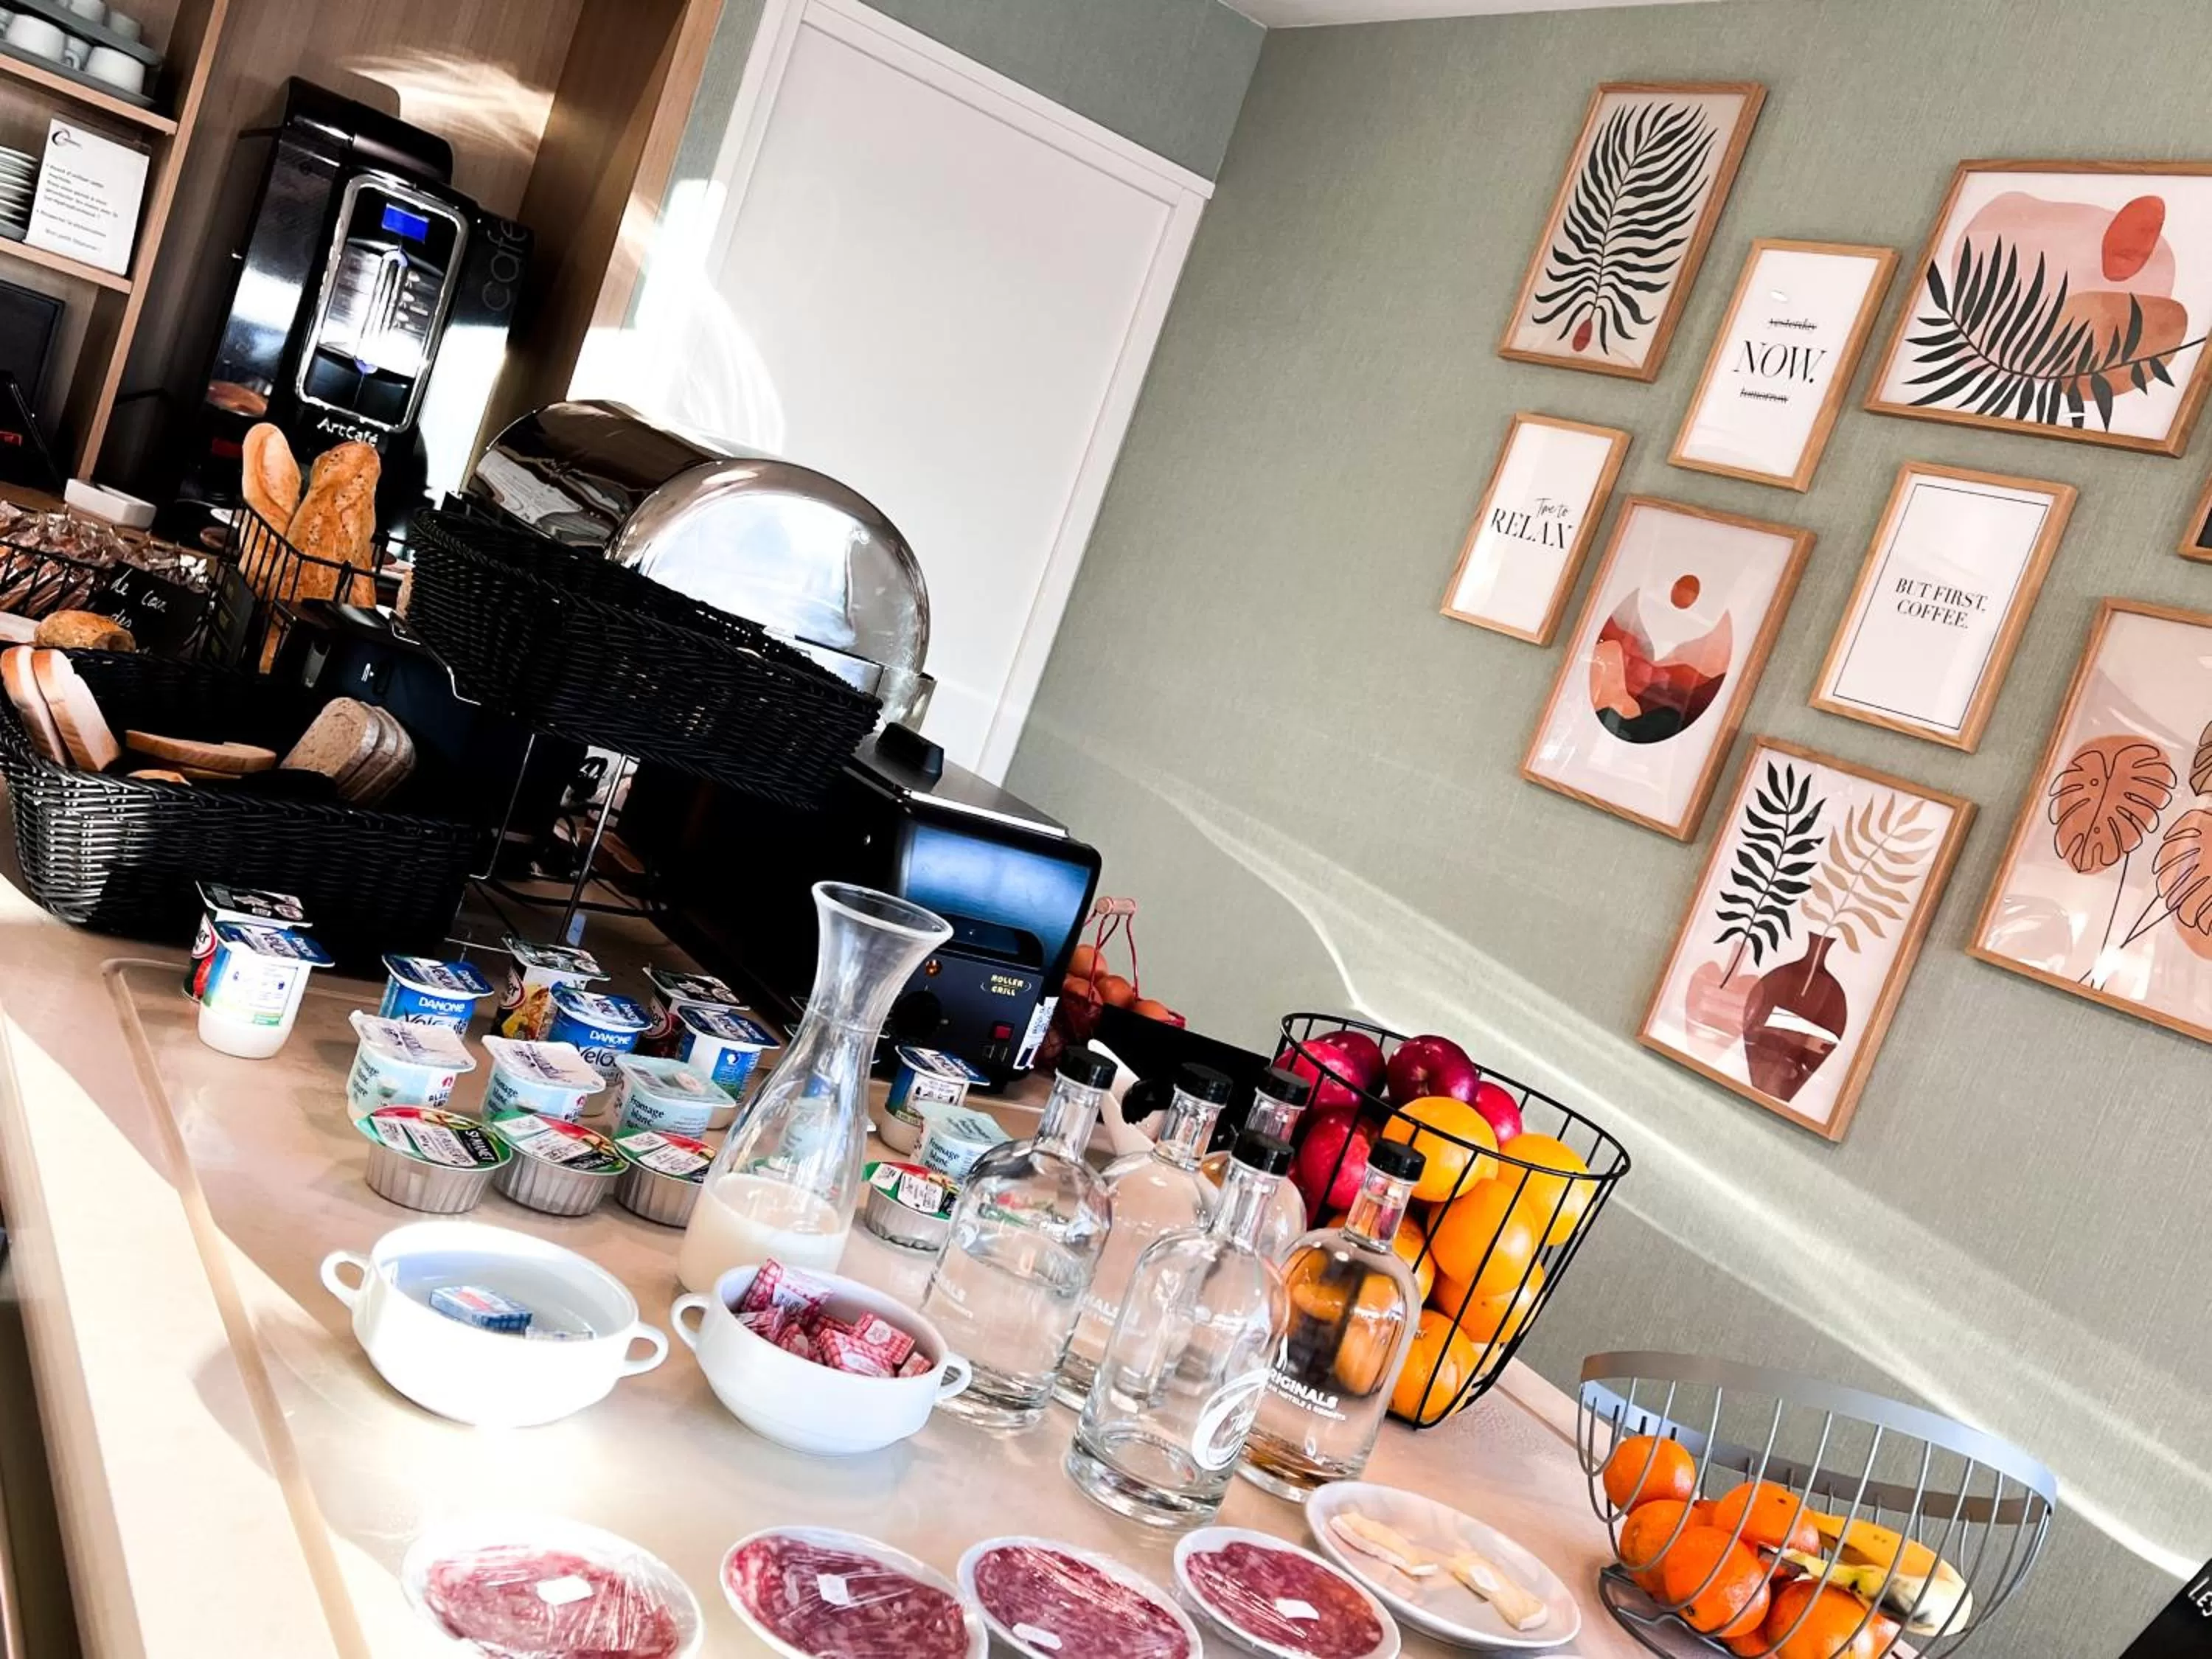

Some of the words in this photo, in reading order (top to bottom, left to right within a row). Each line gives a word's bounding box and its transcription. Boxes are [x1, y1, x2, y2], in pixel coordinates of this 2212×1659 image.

[1733, 340, 1827, 383] NOW.
[1490, 508, 1573, 549] RELAX
[1895, 578, 1933, 598] BUT
[990, 974, 1023, 988] ROLLER
[990, 986, 1016, 997] GRILL
[418, 996, 466, 1013] DANONE
[589, 1030, 632, 1045] DANONE
[1269, 1368, 1339, 1410] RIGINALS
